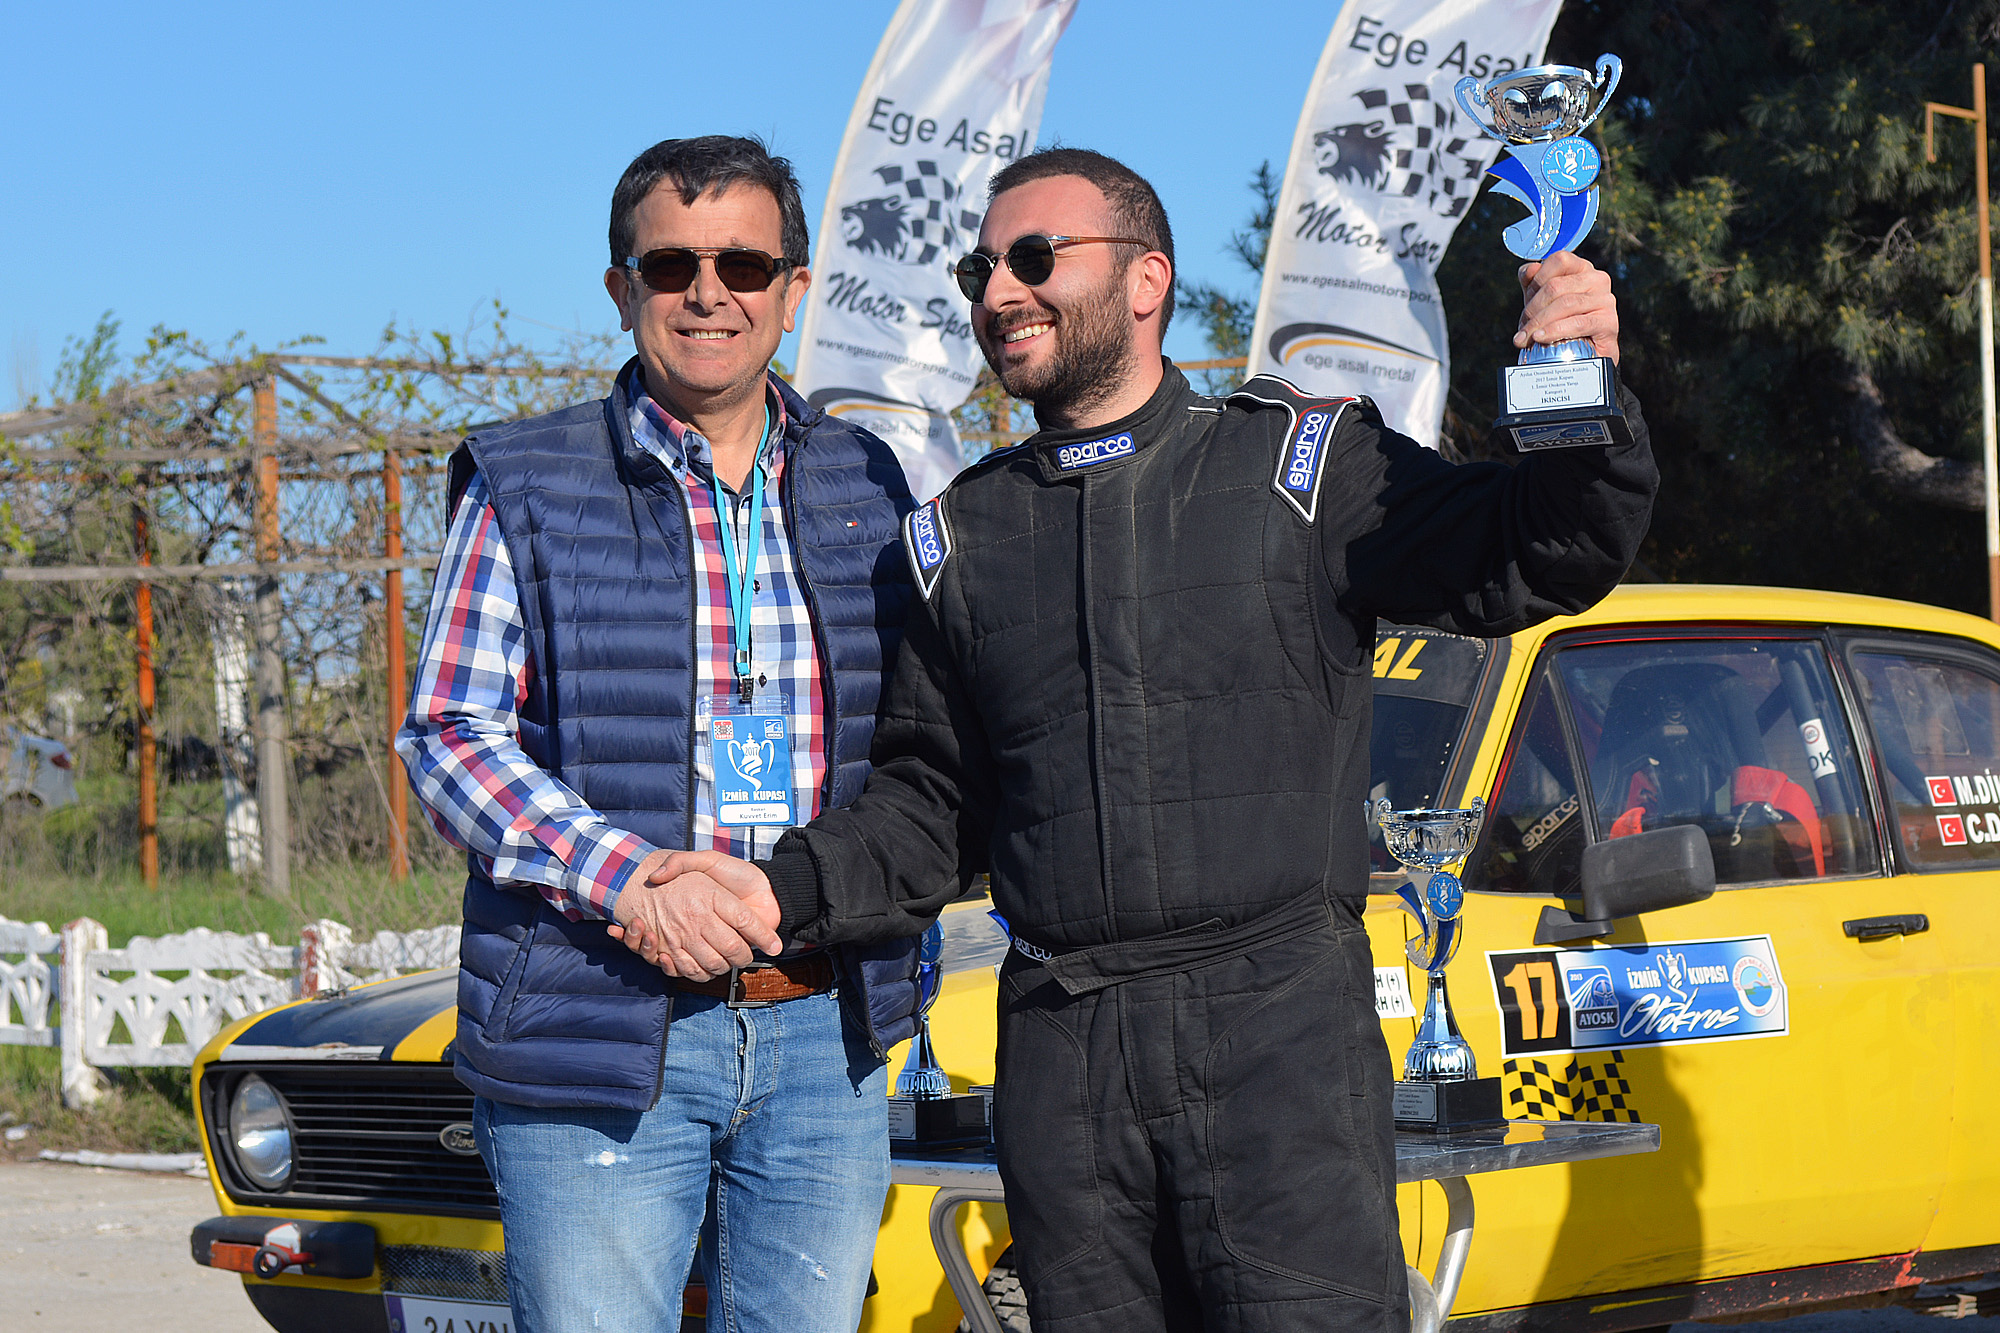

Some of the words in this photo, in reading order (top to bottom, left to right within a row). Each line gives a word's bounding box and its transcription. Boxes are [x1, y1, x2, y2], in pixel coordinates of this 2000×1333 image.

[1349, 16, 1428, 68] Ege
[867, 97, 937, 145] Ege
[944, 118, 1028, 159] Asal
[1296, 201, 1388, 254] Motor
[828, 272, 907, 322] Motor
[920, 298, 973, 342] Spo
[1304, 353, 1333, 370] ege
[1338, 358, 1369, 375] asal
[1372, 364, 1416, 382] metal
[1059, 436, 1132, 468] sparco
[1289, 413, 1326, 488] sparco
[1533, 437, 1596, 448] AYOSK
[913, 505, 940, 566] sparco
[1808, 750, 1836, 771] OK
[722, 789, 749, 802] İZMİR
[753, 790, 786, 801] KUPASI
[1569, 973, 1583, 981] 2013
[1626, 966, 1662, 990] İZMİR
[1687, 965, 1730, 985] KUPASI
[1503, 961, 1559, 1041] 17
[1579, 1010, 1615, 1026] AYOSK
[1619, 986, 1740, 1038] Otokros
